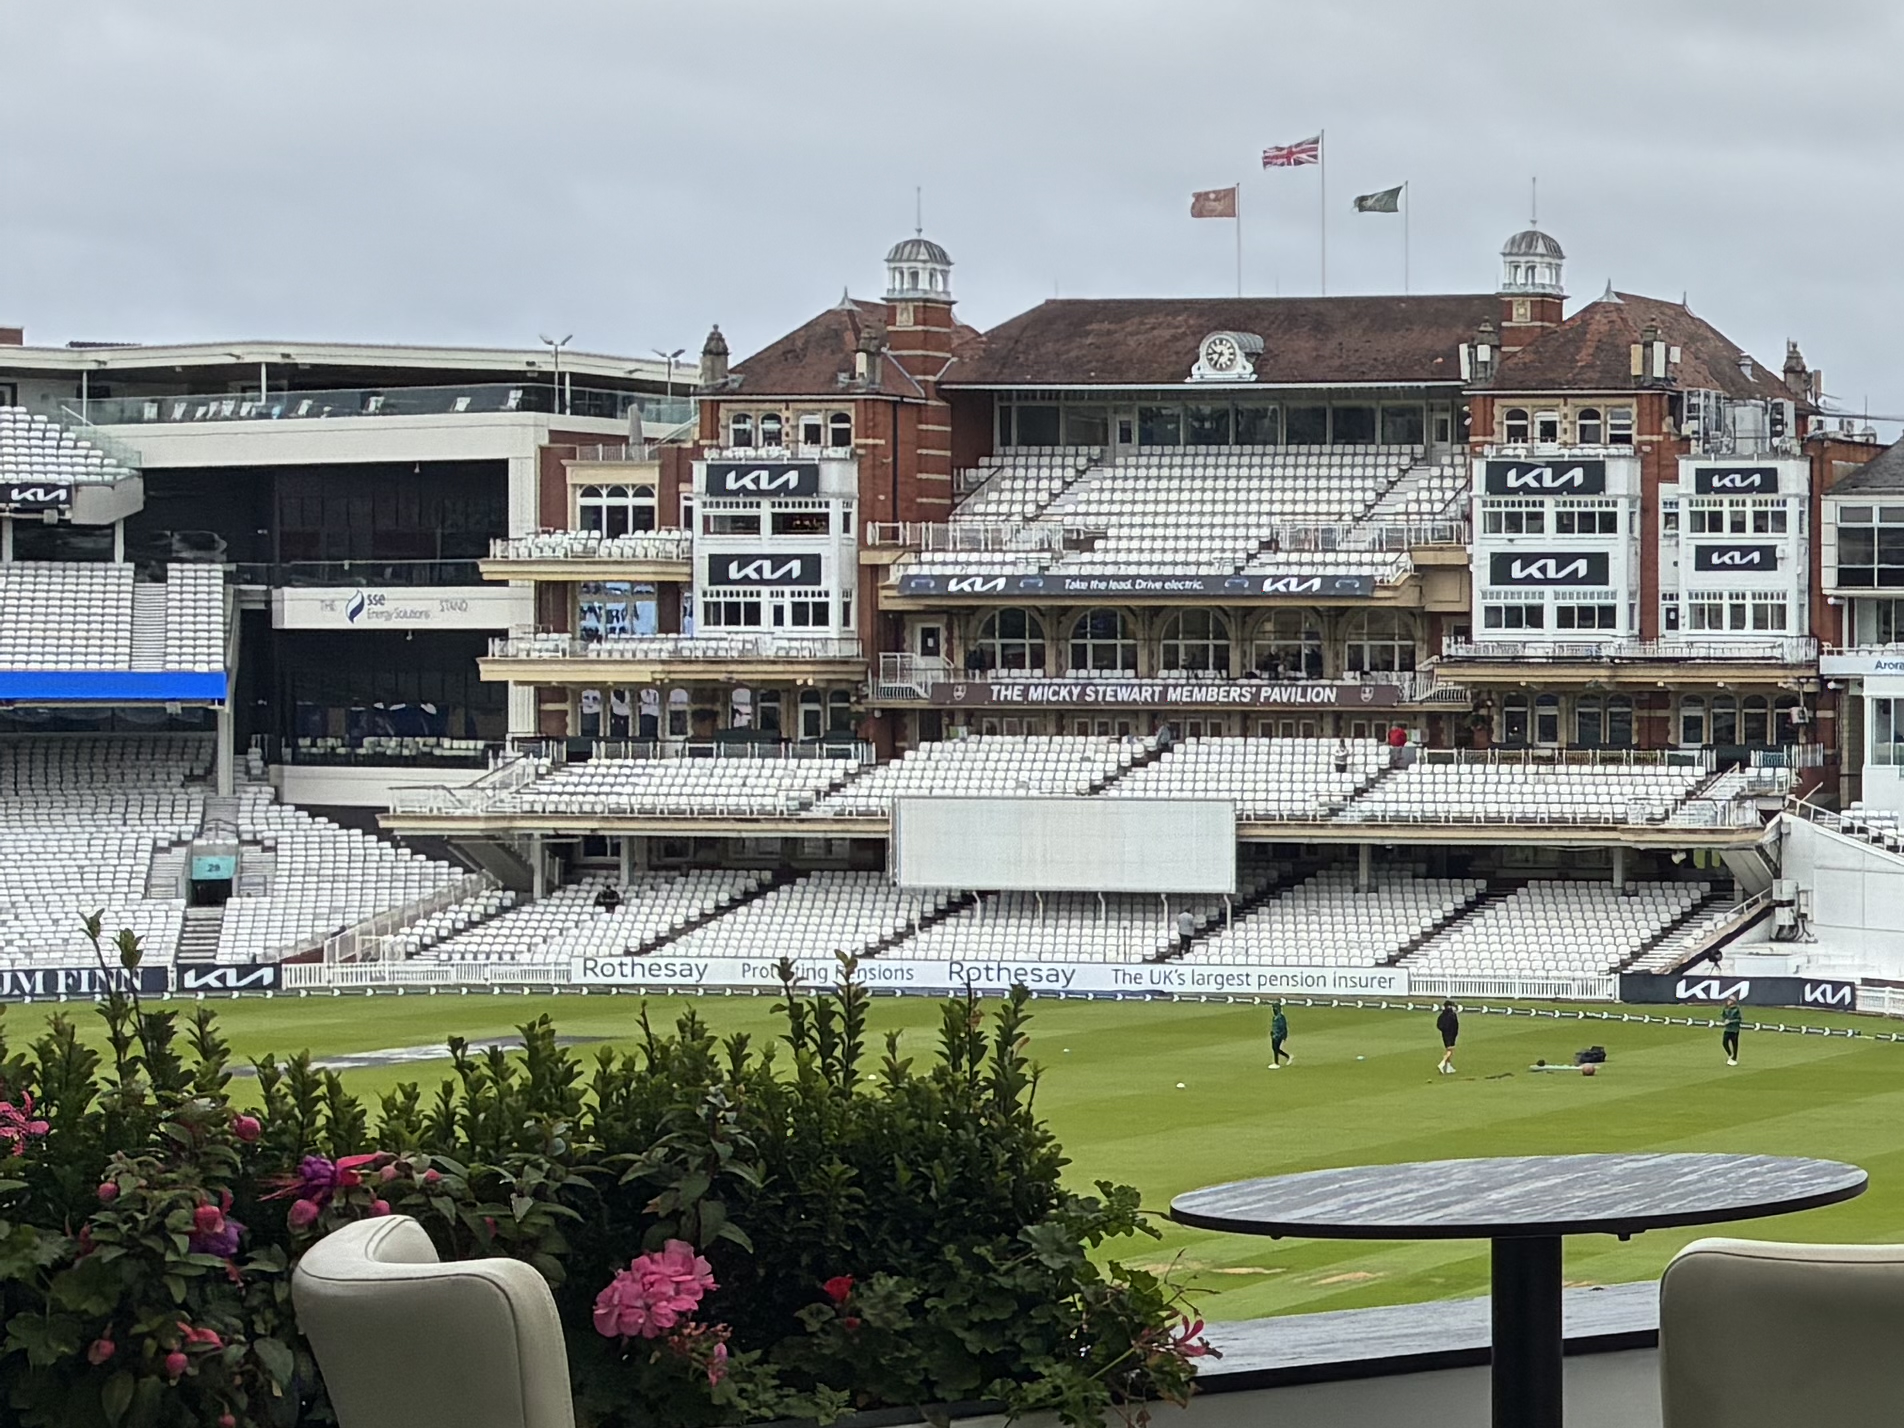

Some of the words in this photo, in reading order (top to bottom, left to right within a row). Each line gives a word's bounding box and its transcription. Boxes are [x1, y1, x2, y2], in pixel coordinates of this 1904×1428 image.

[726, 470, 799, 491] KIA
[1507, 467, 1584, 488] KIA
[1711, 473, 1761, 489] KIA
[11, 488, 67, 501] KIA
[1711, 550, 1761, 566] KIA
[728, 559, 802, 580] KIA
[1511, 558, 1588, 580] KIA
[1065, 579, 1087, 590] Take
[1135, 579, 1162, 590] Drive
[367, 593, 385, 606] sse
[991, 685, 1024, 701] THE
[1028, 685, 1080, 702] MICKY
[1086, 685, 1163, 703] STEWART
[1167, 686, 1256, 703] MEMBERS'
[1260, 686, 1337, 703] PAVILION
[57, 968, 143, 993] FINN
[184, 967, 274, 988] KIA
[583, 957, 708, 982] Rothesay
[743, 962, 828, 984] Protting
[949, 961, 1076, 987] Rothesay
[1112, 969, 1143, 985] The
[1191, 969, 1252, 992] largest
[1257, 970, 1327, 991] pension
[1333, 971, 1396, 990] insurer
[1676, 978, 1750, 1000] KIA
[1804, 982, 1851, 1006] KIA
